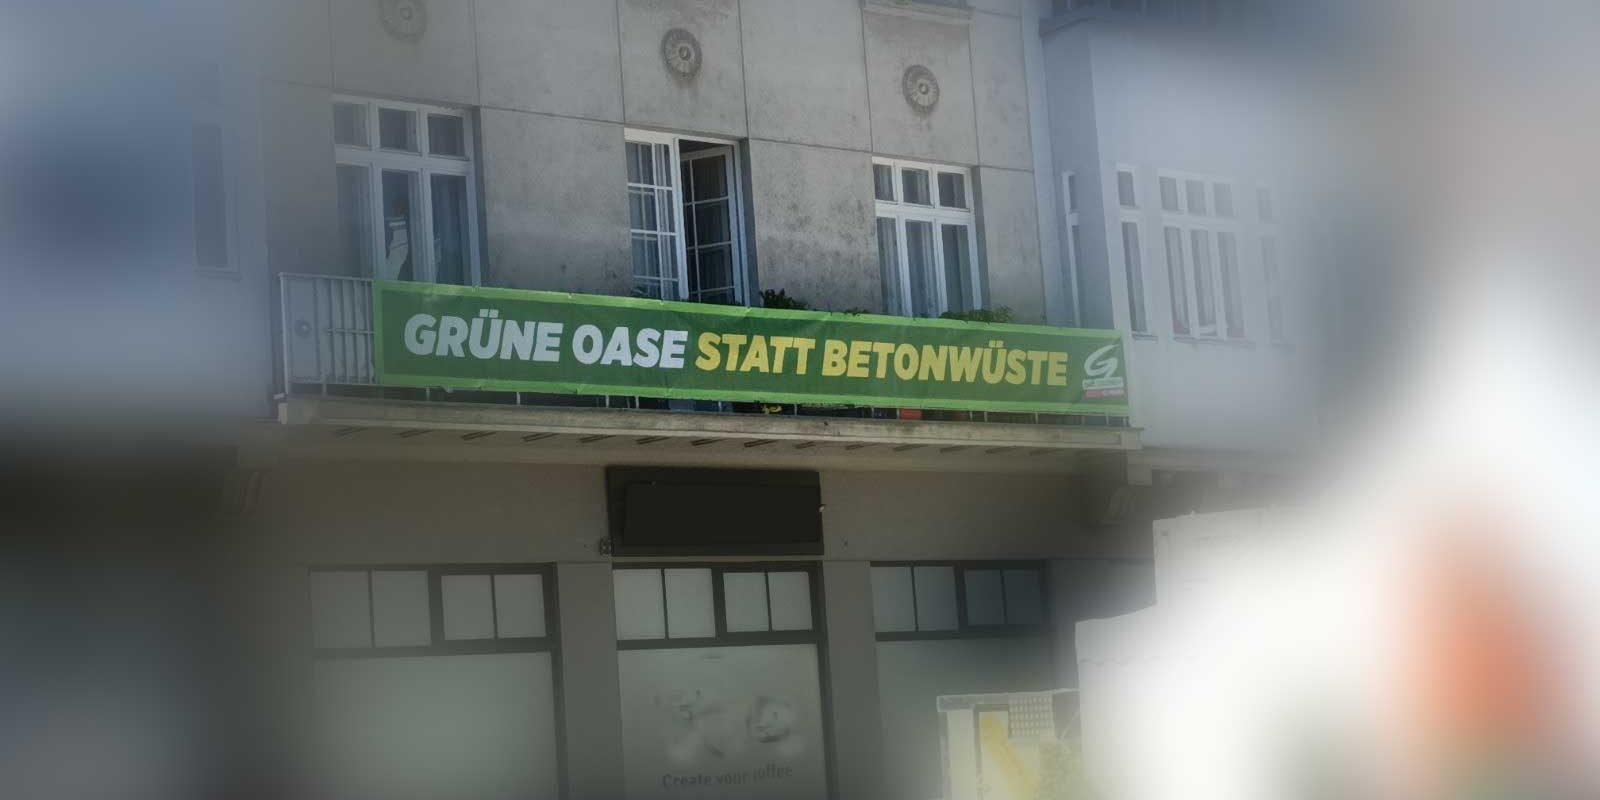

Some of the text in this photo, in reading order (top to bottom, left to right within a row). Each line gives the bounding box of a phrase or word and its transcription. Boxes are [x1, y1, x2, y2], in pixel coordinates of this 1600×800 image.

[404, 309, 1068, 386] GRÜNE OASE STATT BETONWÜSTE
